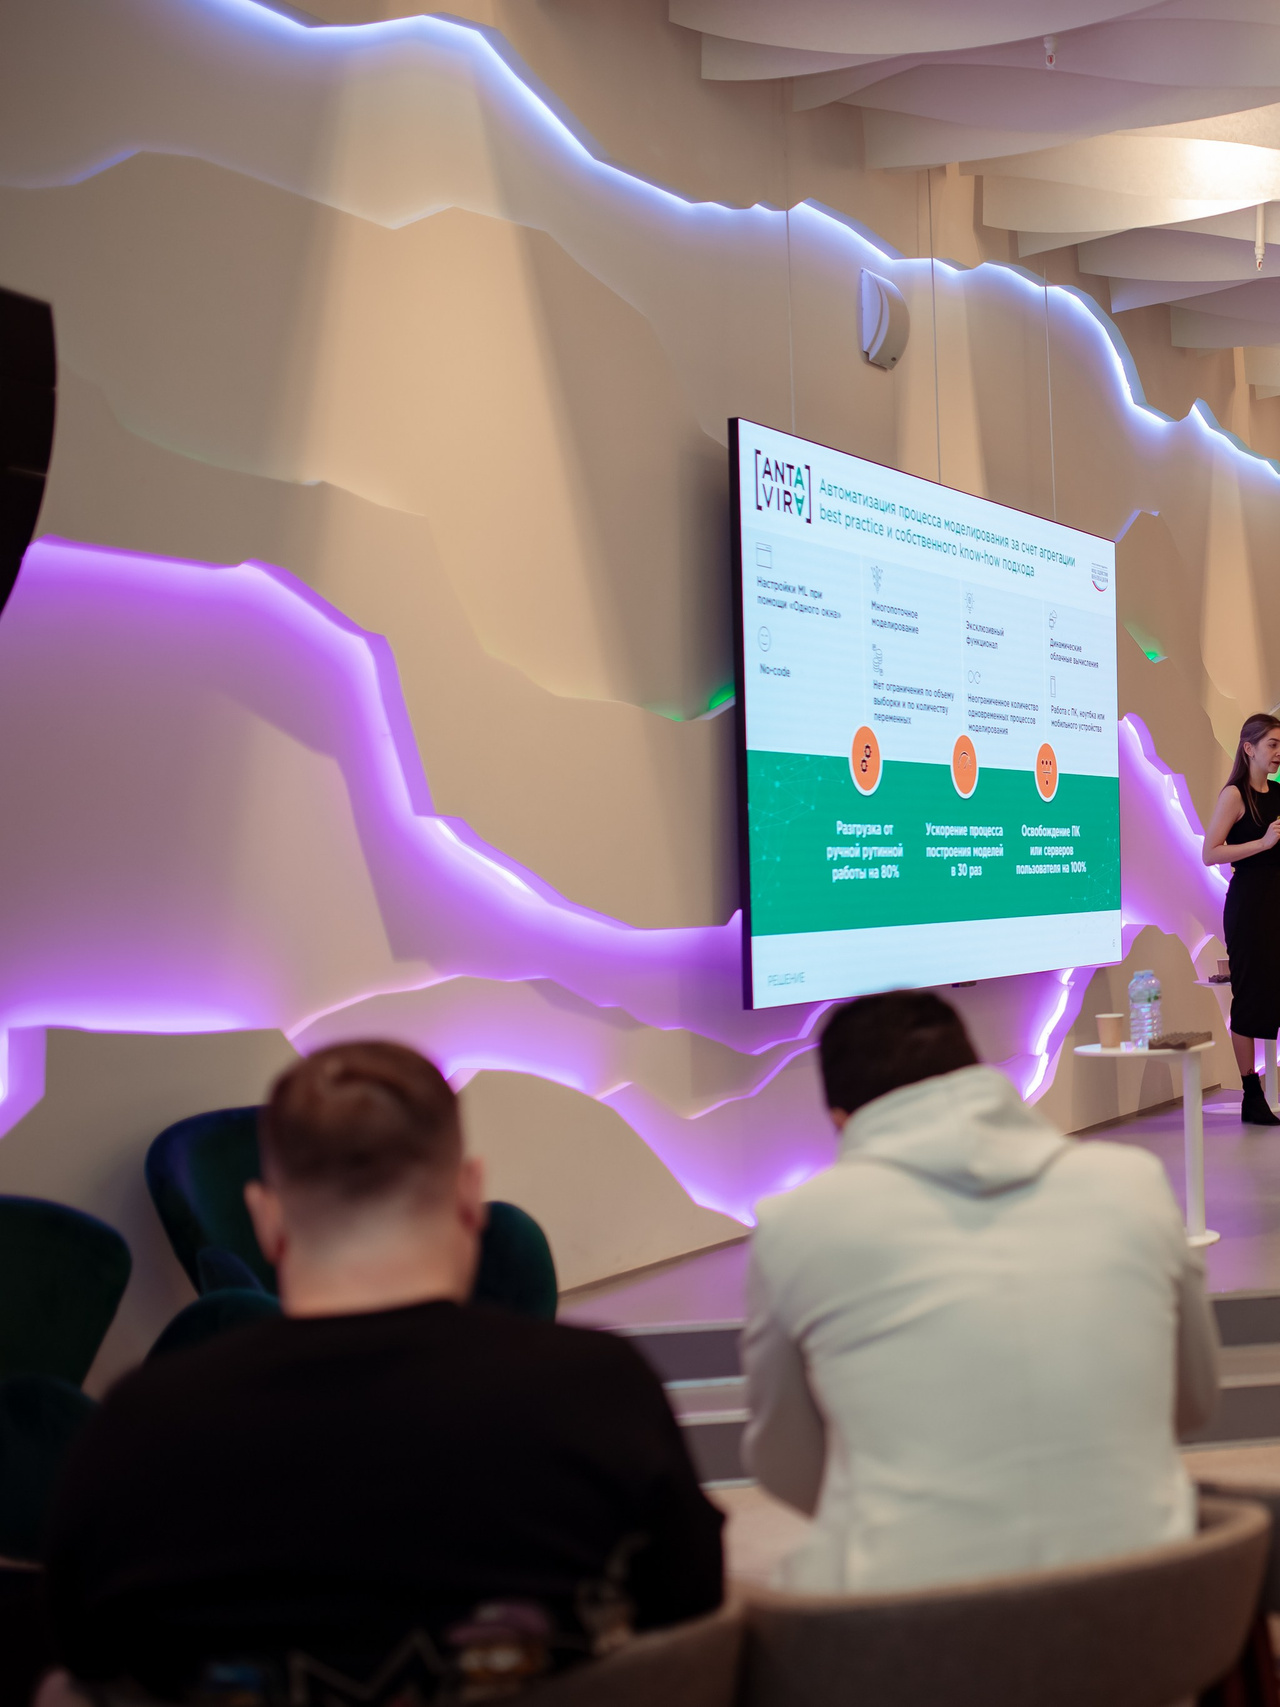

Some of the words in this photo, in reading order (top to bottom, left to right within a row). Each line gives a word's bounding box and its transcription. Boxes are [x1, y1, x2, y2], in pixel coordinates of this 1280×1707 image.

[819, 478, 896, 515] Автоматизация
[899, 504, 942, 528] процесса
[944, 520, 1009, 546] моделирования
[1011, 539, 1019, 550] за
[1021, 541, 1037, 556] счет
[1040, 547, 1075, 567] агрегации
[819, 503, 842, 525] best
[845, 513, 884, 538] practice
[887, 526, 892, 537] и
[895, 529, 957, 556] собственного
[960, 543, 999, 567] know-how
[1002, 558, 1035, 577] подхода
[757, 576, 796, 593] Настройки
[798, 585, 808, 596] ML
[810, 590, 822, 600] при
[757, 596, 787, 610] помощи
[871, 600, 918, 619] Многопоточное
[871, 618, 919, 634] моделирование
[966, 620, 1004, 636] Эксклюзивный
[966, 635, 998, 649] функционал
[1050, 638, 1082, 653] Динамические
[1050, 652, 1072, 664] облачные
[1073, 657, 1099, 668] вычисления
[760, 663, 791, 677] No-code
[873, 680, 884, 689] Нет
[886, 683, 923, 695] ограничения
[925, 688, 932, 697] по
[874, 696, 900, 708] выборки
[916, 703, 948, 715] количеству
[968, 693, 1010, 708] Неограниченное
[1011, 701, 1039, 711] количество
[1051, 705, 1066, 715] Работа
[874, 713, 911, 724] переменных
[968, 709, 1009, 721] одновременных
[1010, 715, 1036, 724] процессов
[968, 724, 1008, 735] моделирования
[1051, 719, 1078, 729] мобильного
[1079, 723, 1102, 732] устройства
[836, 820, 882, 838] Разгрузка
[883, 824, 894, 835] от
[925, 822, 967, 838] Ускорение
[969, 826, 1003, 839] процесса
[1022, 824, 1070, 838] Освобождение
[1071, 825, 1080, 837] ПК
[826, 843, 861, 861] ручной
[862, 843, 903, 861] рутинной
[926, 846, 971, 860] построения
[973, 844, 1003, 858] моделей
[1030, 845, 1043, 856] или
[1044, 845, 1074, 858] серверов
[832, 864, 866, 883] работы
[868, 867, 879, 879] на
[881, 864, 899, 878] 80%
[951, 866, 956, 877] в
[957, 864, 967, 877] 30
[969, 865, 982, 878] раз
[1016, 863, 1060, 875] пользователя
[1062, 864, 1070, 873] на
[1070, 862, 1086, 873] 100%
